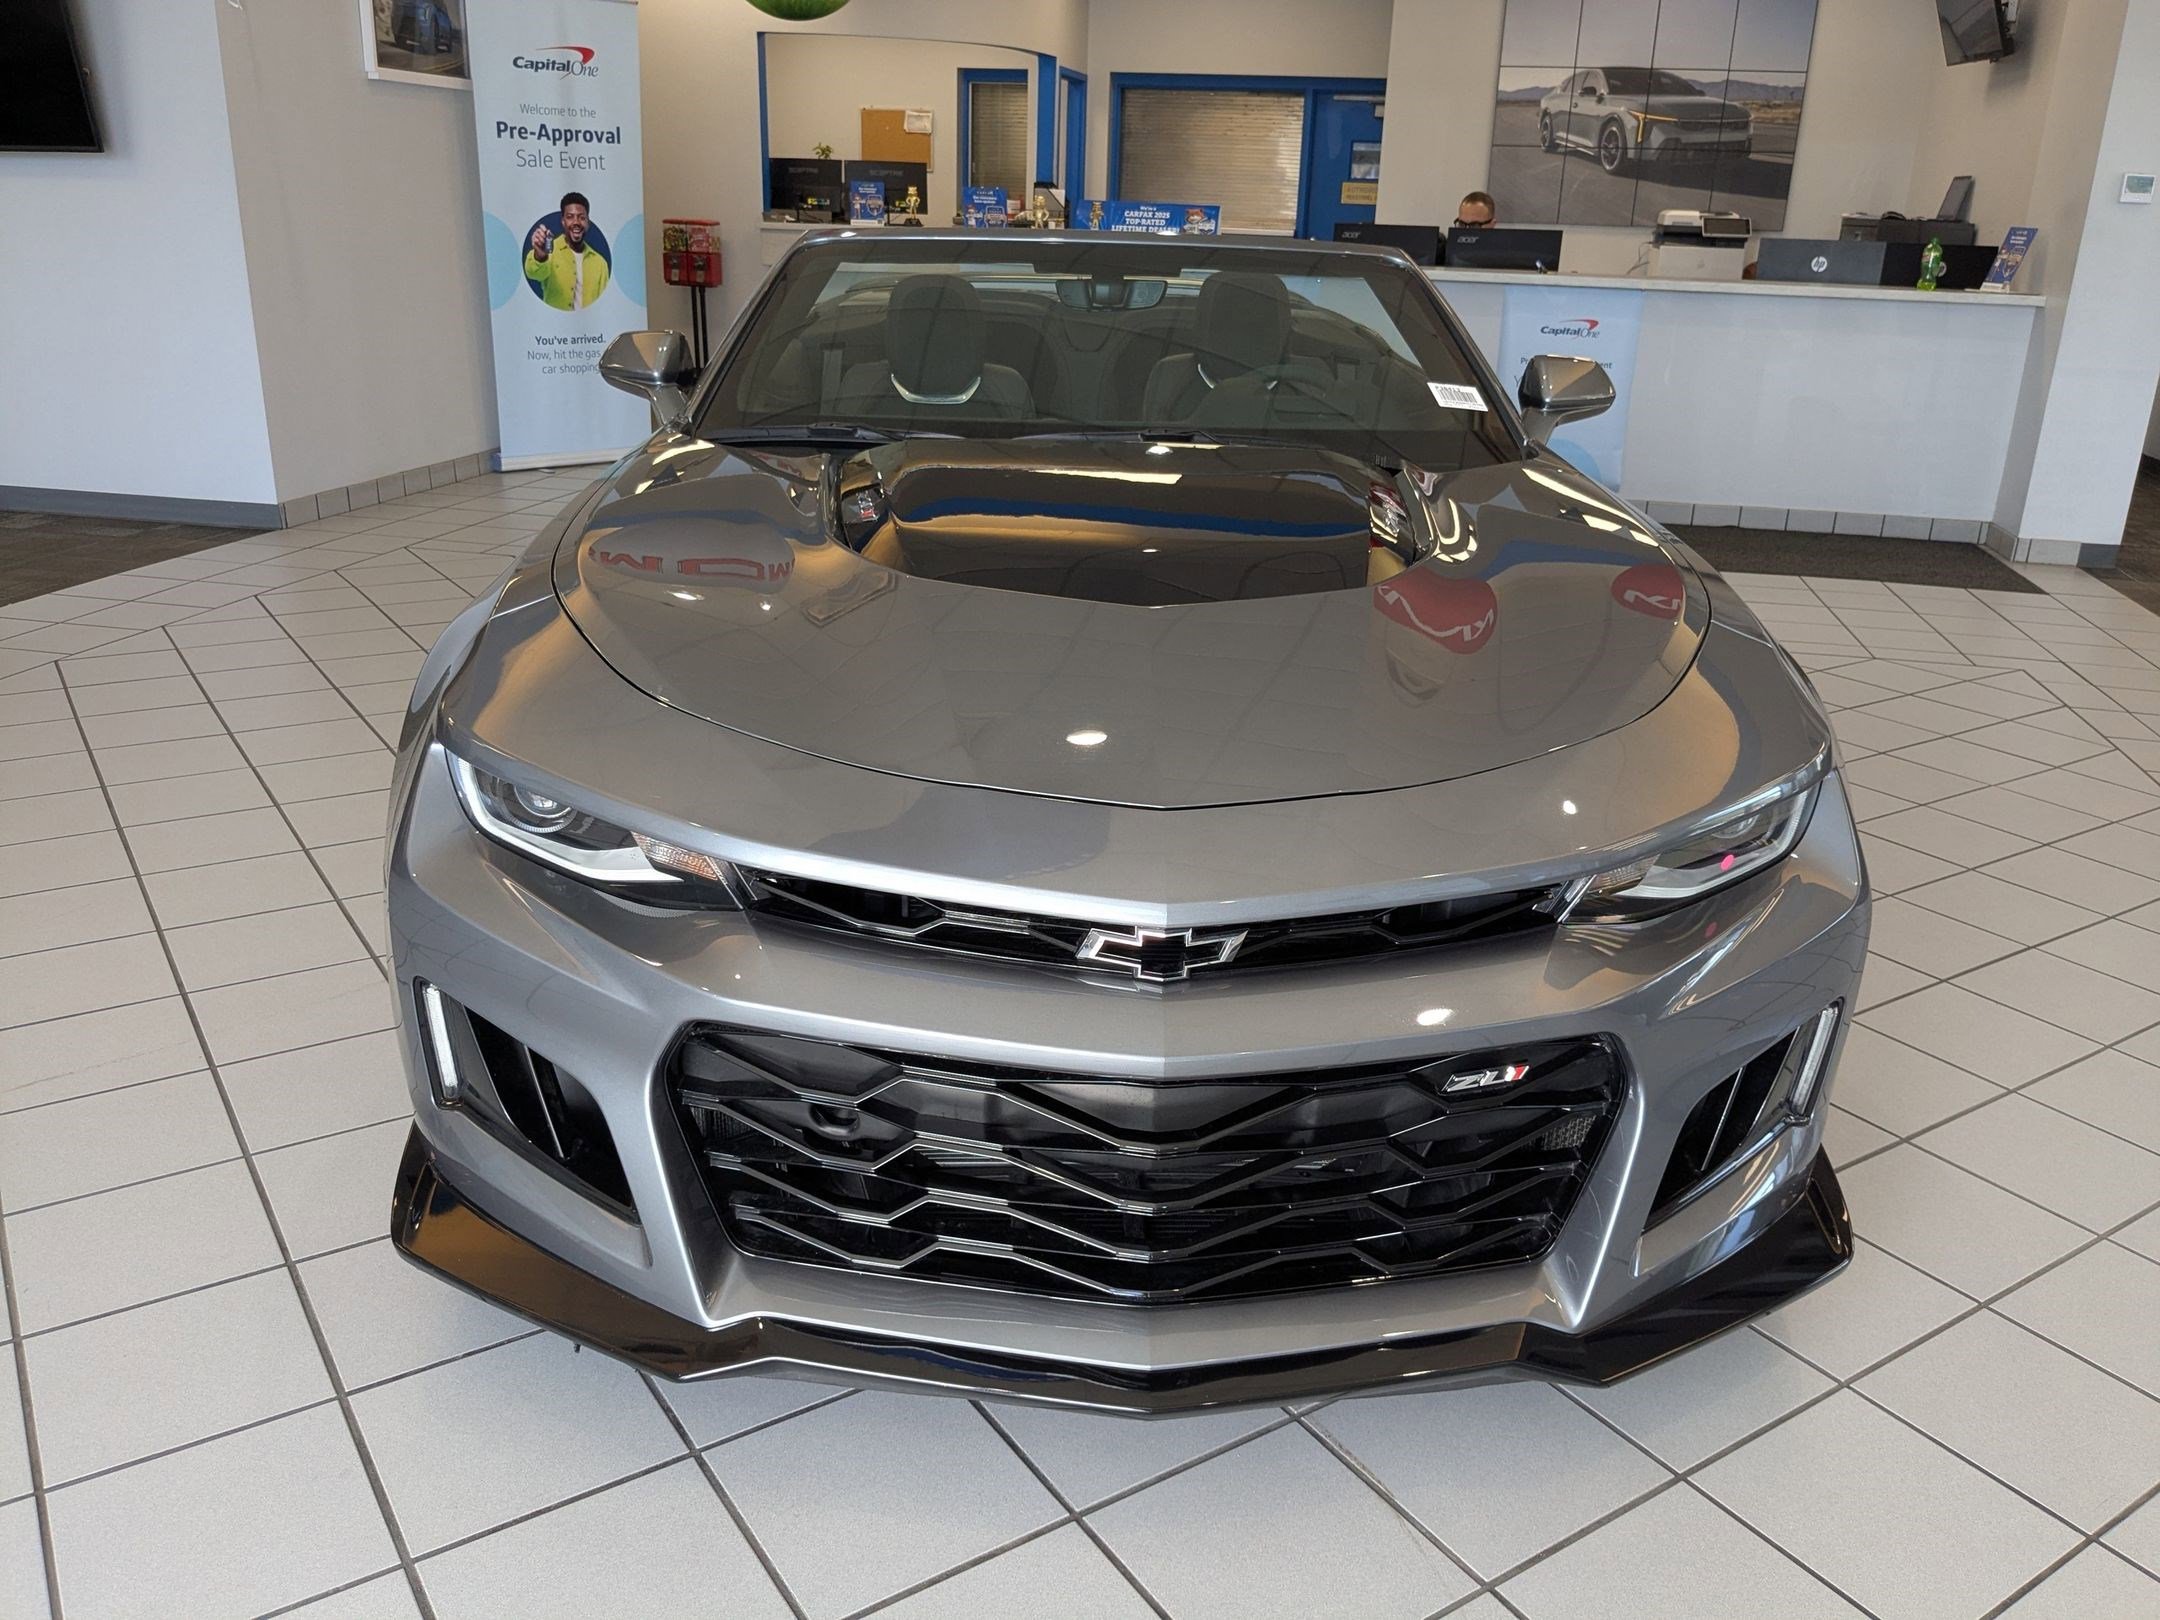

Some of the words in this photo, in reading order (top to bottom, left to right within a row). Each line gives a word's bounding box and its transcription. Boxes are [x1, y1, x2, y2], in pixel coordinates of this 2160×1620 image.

[519, 103, 566, 117] Welcome
[567, 106, 577, 117] to
[579, 106, 597, 118] the
[496, 120, 621, 147] Pre-Approval
[516, 148, 554, 169] Sale
[559, 151, 606, 170] Event
[1124, 210, 1153, 218] CARFAX
[1154, 211, 1170, 219] 2025
[1111, 224, 1147, 233] LIFETIME
[1341, 231, 1361, 239] acer
[1457, 235, 1480, 244] acer
[535, 335, 568, 346] You've
[570, 333, 606, 345] arrived.
[527, 350, 552, 361] Now,
[553, 349, 567, 360] hit
[568, 349, 583, 359] the
[542, 366, 557, 375] car
